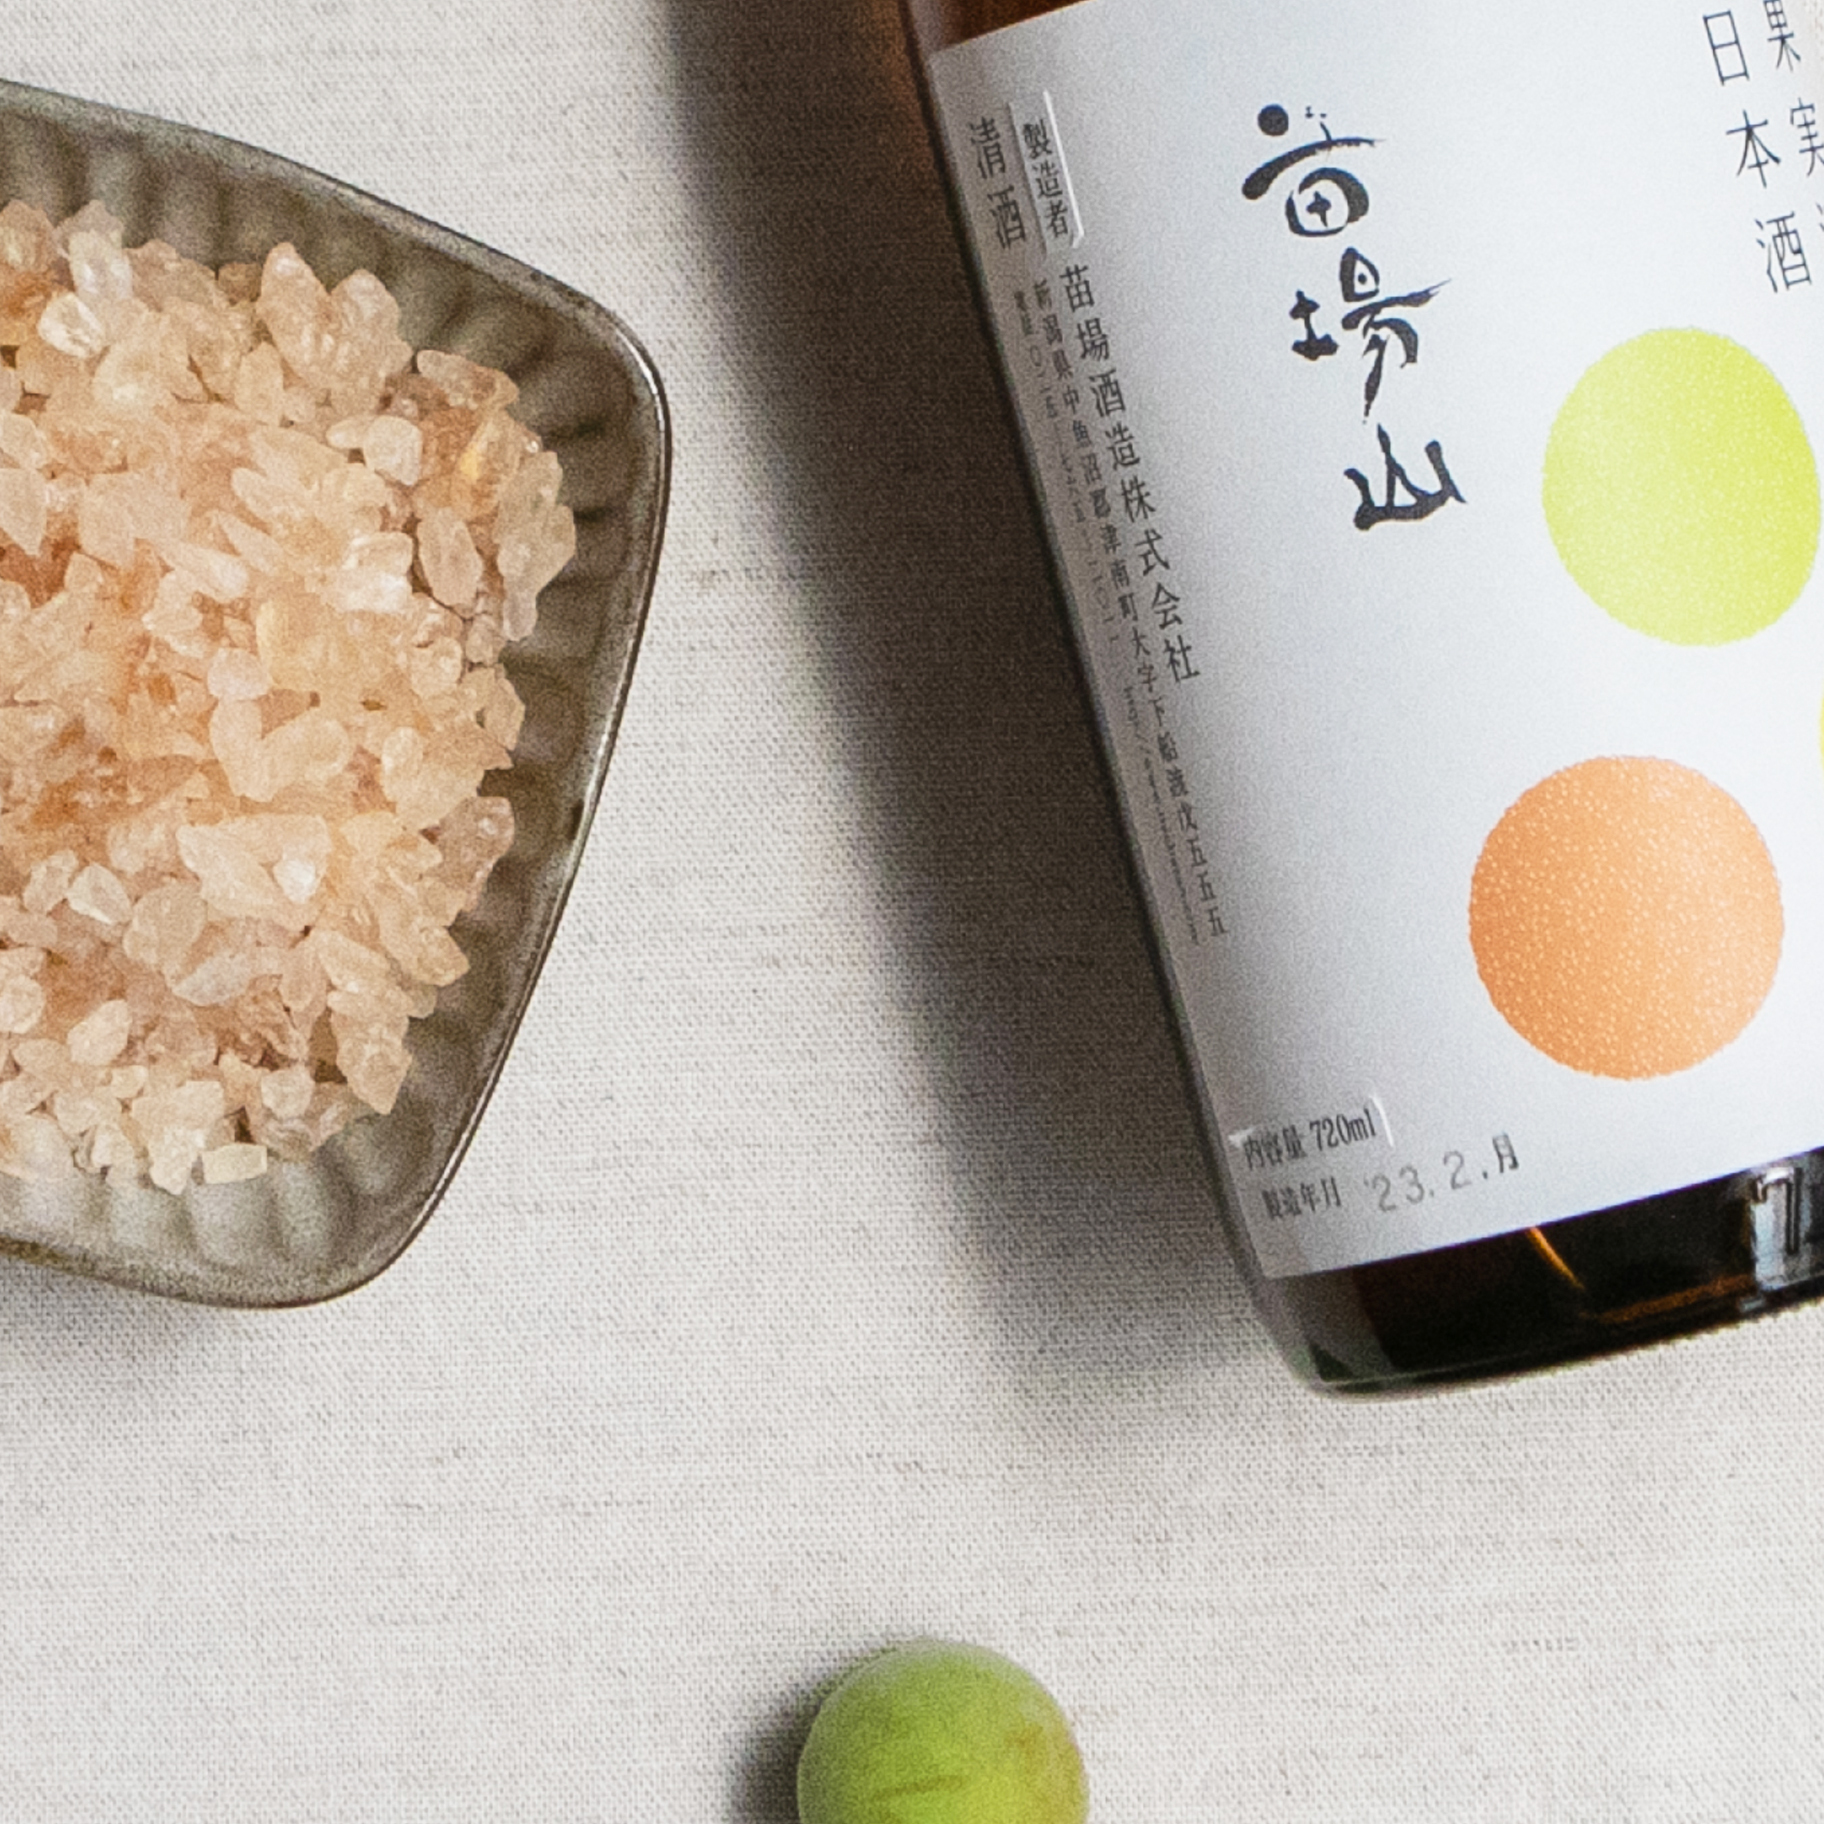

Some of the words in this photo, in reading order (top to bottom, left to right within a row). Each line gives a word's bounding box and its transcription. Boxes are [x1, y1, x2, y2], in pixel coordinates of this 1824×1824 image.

[969, 117, 1027, 250] 清酒
[1022, 117, 1069, 238] 製造者
[1701, 9, 1814, 295] 日本酒
[1241, 104, 1467, 532] 苗場山
[1060, 265, 1200, 683] 苗場酒造株式会社
[1309, 1107, 1377, 1151] 720ml
